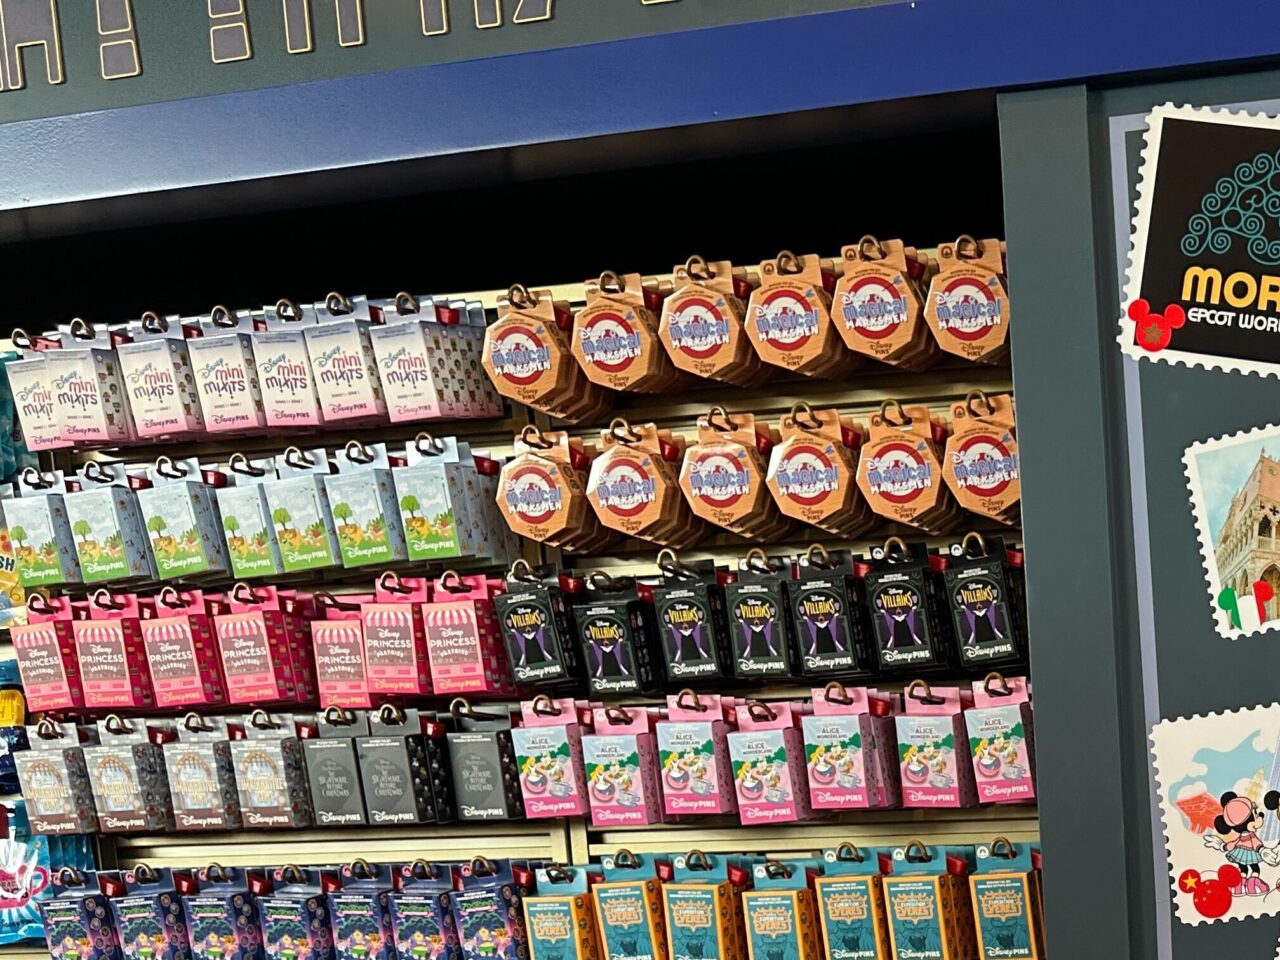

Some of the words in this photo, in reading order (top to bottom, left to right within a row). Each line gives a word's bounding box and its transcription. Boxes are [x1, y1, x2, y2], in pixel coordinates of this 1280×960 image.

[1187, 308, 1235, 326] EPCOT
[368, 639, 411, 648] PRINCESS
[430, 636, 475, 648] PRINCESS
[81, 654, 123, 663] PRINCESS
[151, 651, 193, 663] PRINCESS
[224, 647, 266, 659] PRINCESS
[21, 656, 60, 668] PRINCESS
[319, 655, 362, 664] PRINCESS
